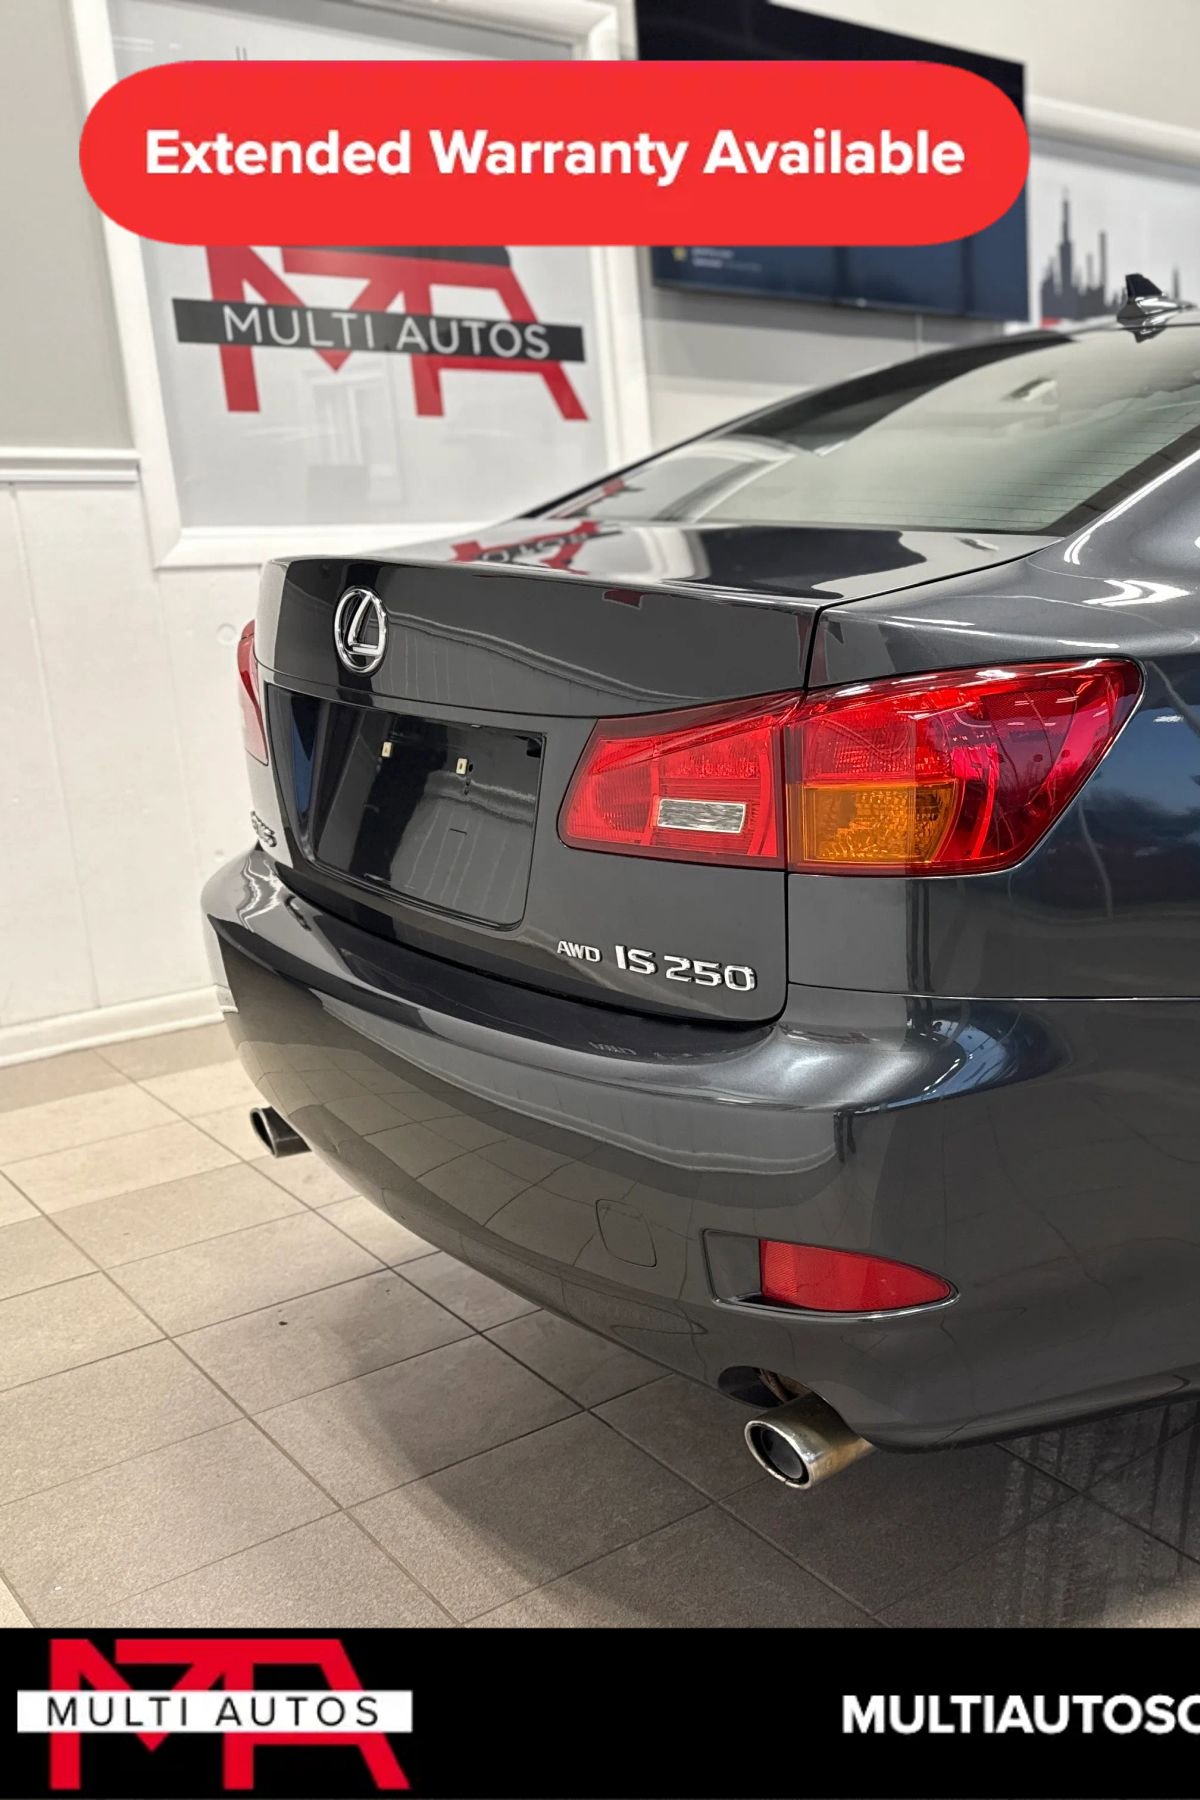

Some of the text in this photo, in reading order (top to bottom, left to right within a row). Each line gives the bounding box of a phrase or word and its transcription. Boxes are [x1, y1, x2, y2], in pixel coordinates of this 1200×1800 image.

[223, 304, 551, 360] MULTI AUTOS
[556, 940, 757, 993] AWD IS 250
